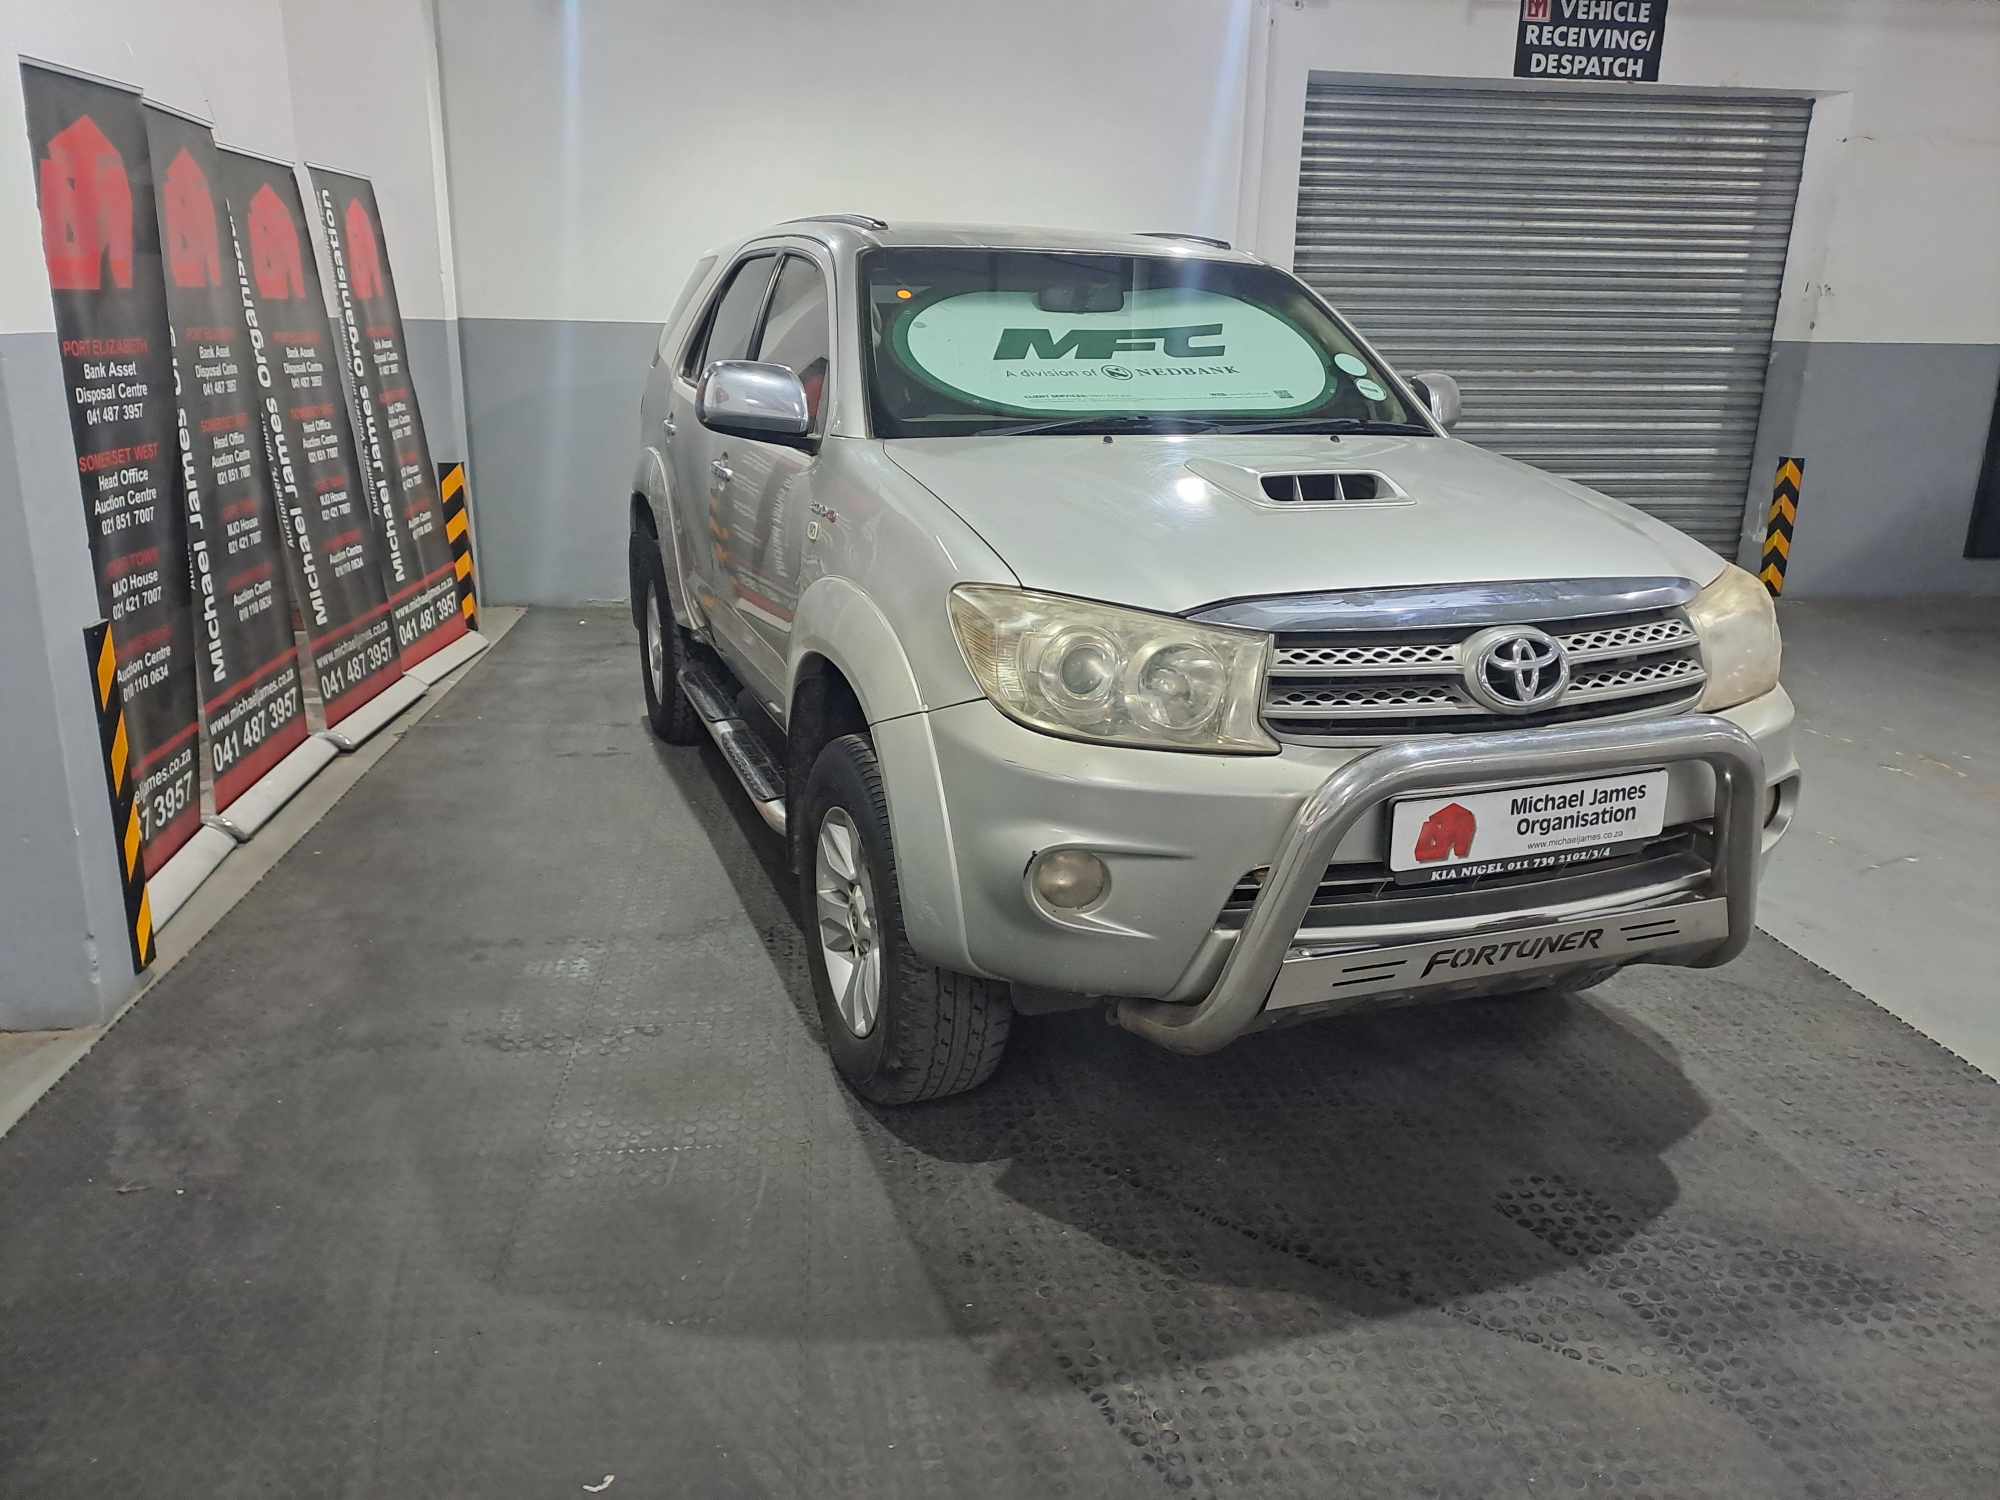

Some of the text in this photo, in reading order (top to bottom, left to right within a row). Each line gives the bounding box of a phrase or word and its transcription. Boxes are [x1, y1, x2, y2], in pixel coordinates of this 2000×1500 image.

[1560, 0, 1652, 23] VEHICLE
[1524, 25, 1656, 52] RECEIVING/
[1530, 53, 1644, 78] DESPATCH
[321, 189, 365, 378] Organisation
[993, 323, 1225, 361] MFC
[84, 361, 138, 380] Bank Asset
[1005, 365, 1241, 378] A division of NEDBANK
[75, 383, 148, 405] Disposal Centre
[86, 403, 144, 426] 041 487 3957
[360, 385, 384, 473] James
[134, 443, 160, 461] WEST
[266, 397, 298, 499] James
[98, 467, 149, 491] Head Office
[94, 487, 157, 516] Auction Centre
[101, 506, 155, 536] 021 851 7007
[376, 480, 406, 583] Michael
[289, 508, 328, 626] Michael
[112, 570, 159, 599] MJO House
[113, 586, 162, 621] 021 421 7007
[193, 540, 226, 682] Michael
[399, 617, 418, 646] 041
[437, 591, 457, 620] 3957
[145, 645, 172, 666] Centre
[321, 636, 392, 699] 041 487 3957
[213, 687, 297, 772] 041 487 3957
[154, 770, 193, 828] 3957
[1510, 784, 1647, 816] Michael James
[1516, 804, 1637, 837] Organisation
[1527, 830, 1624, 850] www.michaeljames.co.za
[1430, 868, 1458, 881] KIA
[1461, 863, 1505, 879] NIGEL
[1507, 860, 1530, 871] 011
[1533, 857, 1555, 869] 739
[1420, 928, 1605, 979] FORTUNER
